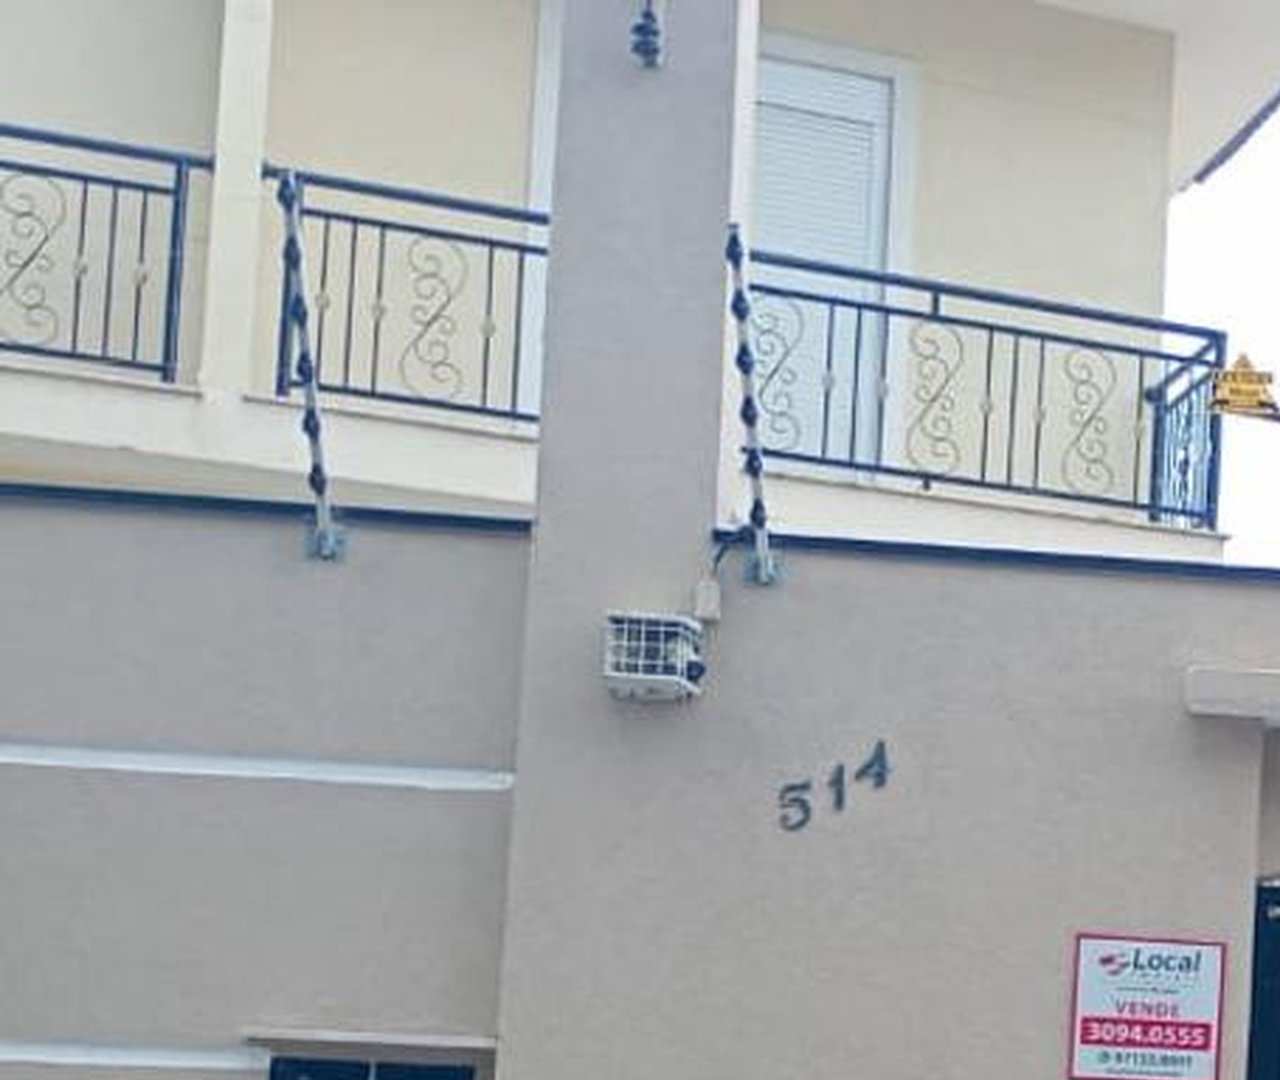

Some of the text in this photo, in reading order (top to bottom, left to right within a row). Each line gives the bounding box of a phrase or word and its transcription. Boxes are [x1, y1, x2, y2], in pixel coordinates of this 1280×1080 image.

[778, 738, 892, 831] 514
[1132, 949, 1202, 972] Local
[1115, 1000, 1181, 1018] VENDE
[1082, 1022, 1206, 1046] 3094.0555
